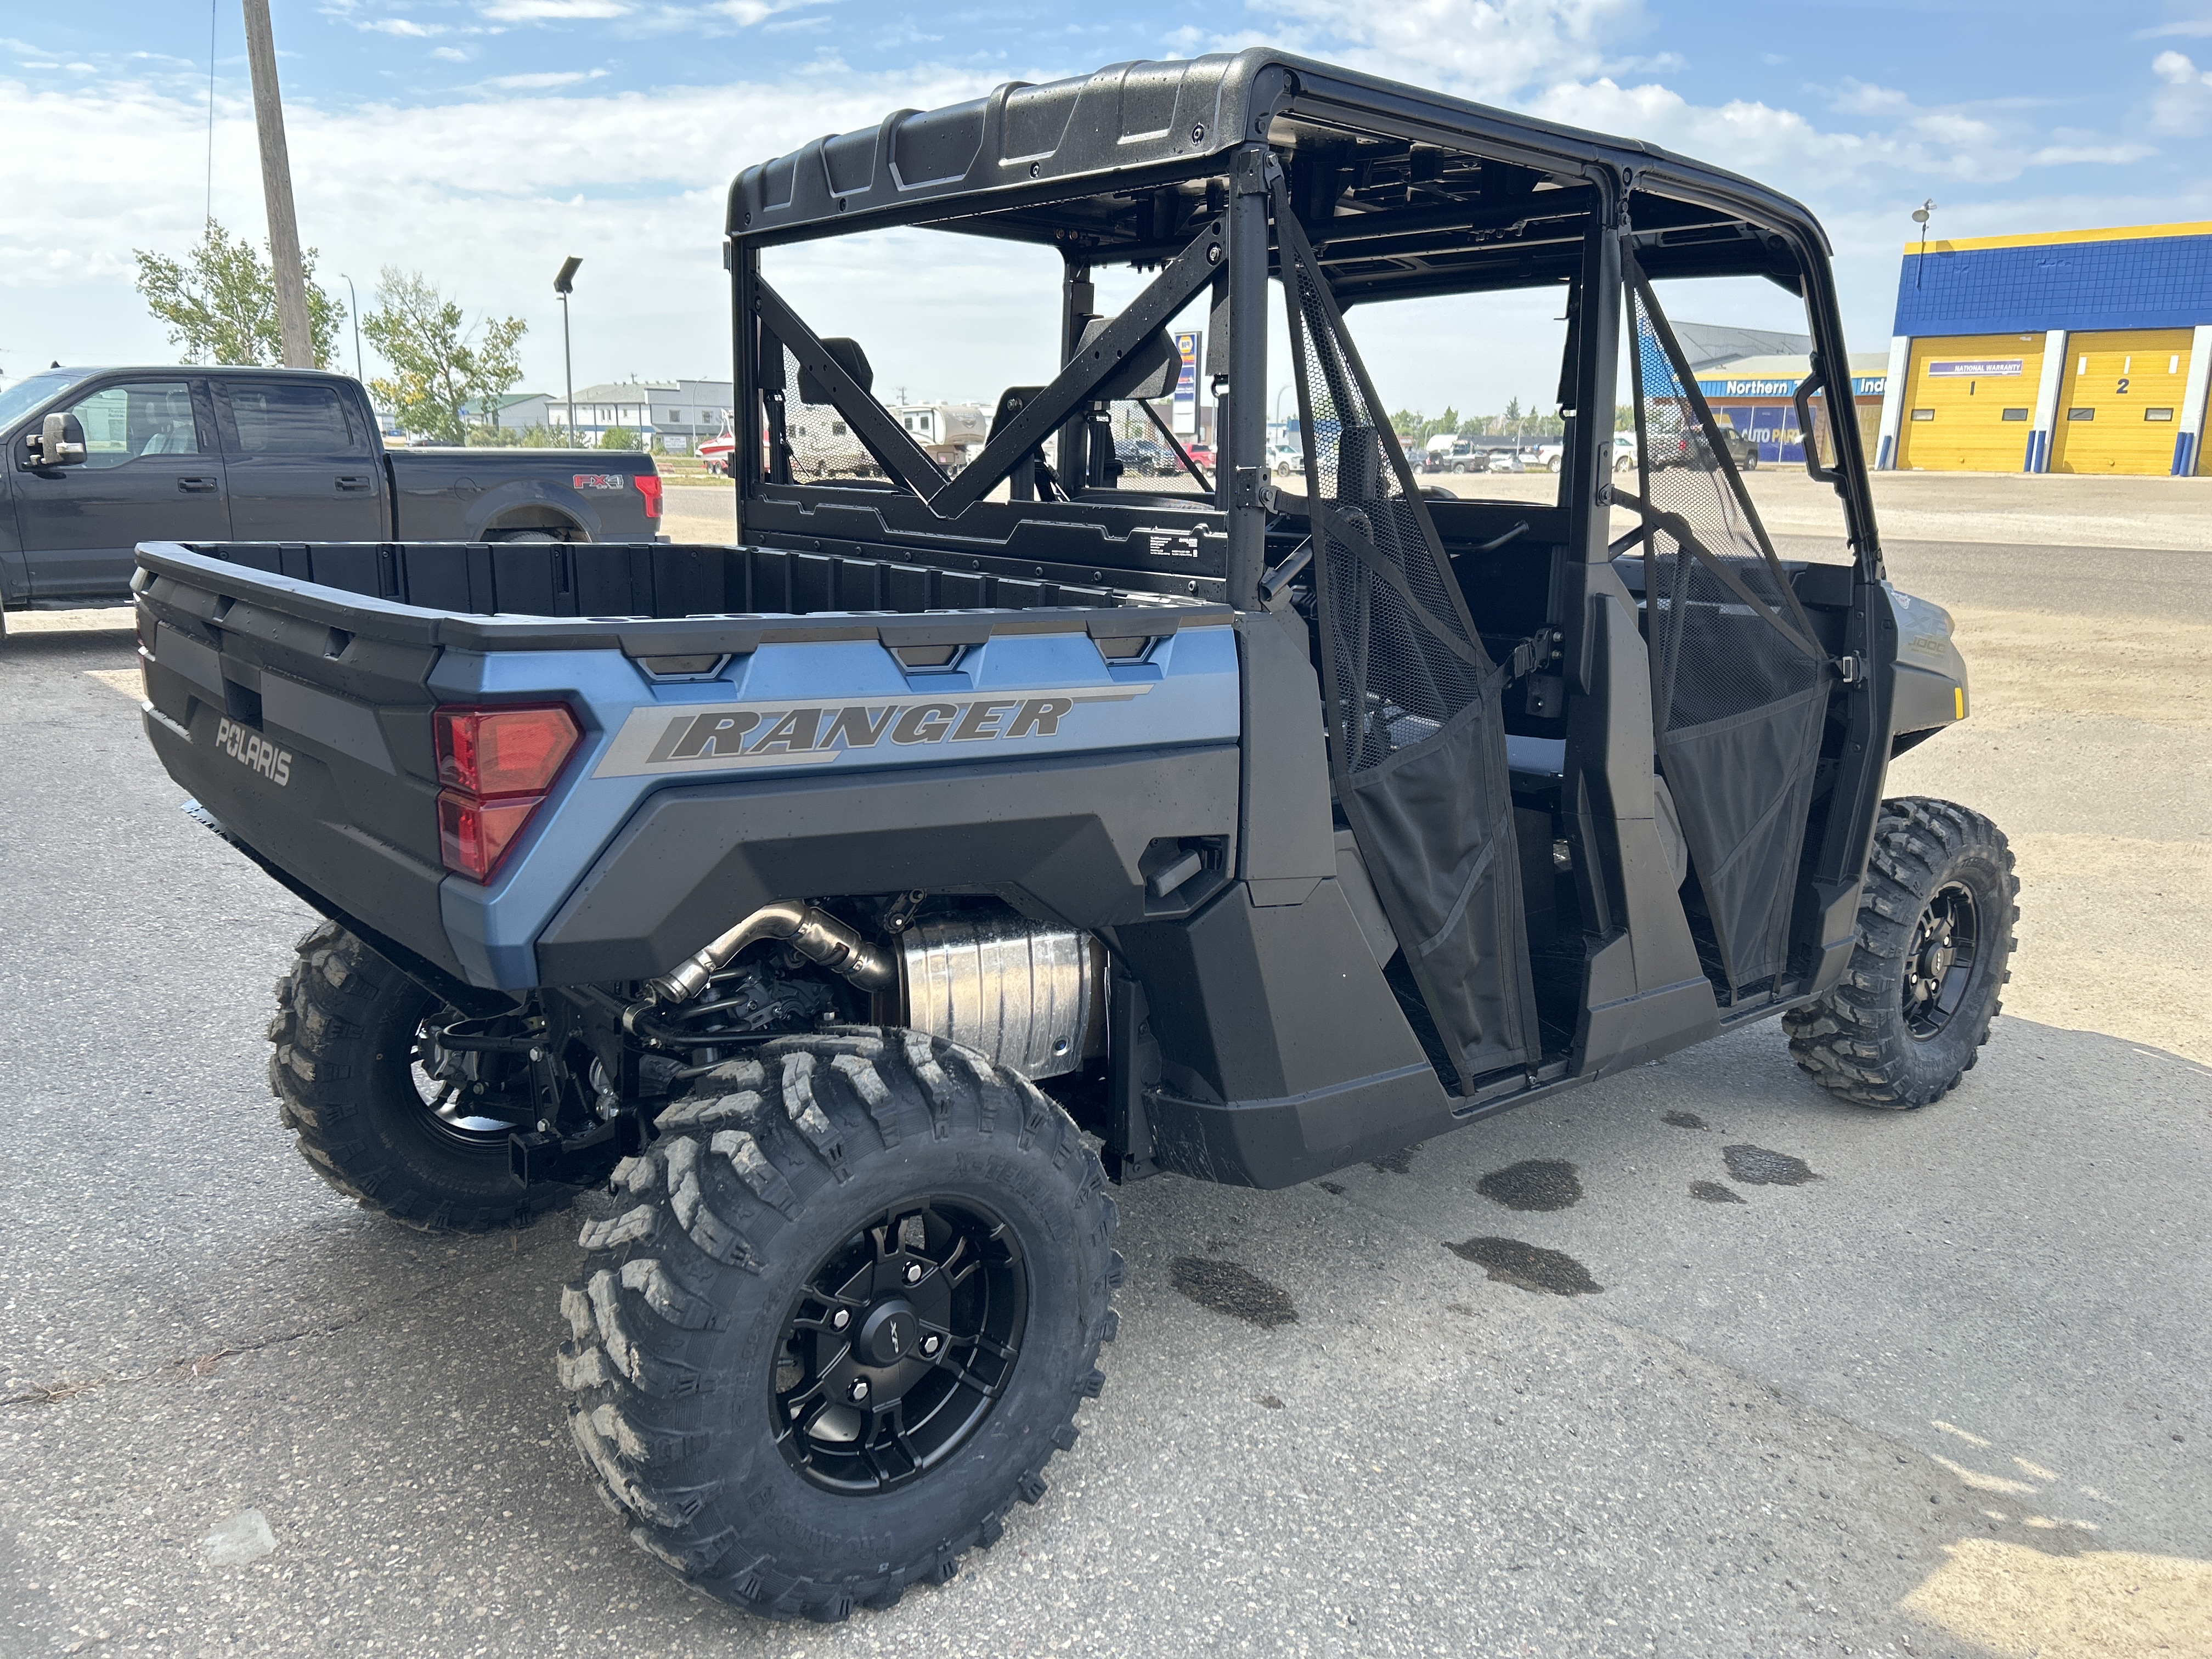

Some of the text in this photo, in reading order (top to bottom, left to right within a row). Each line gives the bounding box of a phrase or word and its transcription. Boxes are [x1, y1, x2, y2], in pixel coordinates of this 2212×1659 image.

[1726, 380, 1787, 394] Northern
[1970, 380, 1975, 396] 1
[2116, 379, 2130, 394] 2
[1741, 428, 1770, 443] AUTO
[573, 474, 624, 489] FX4
[667, 697, 1074, 760] RANGER
[216, 717, 292, 786] POLARIS
